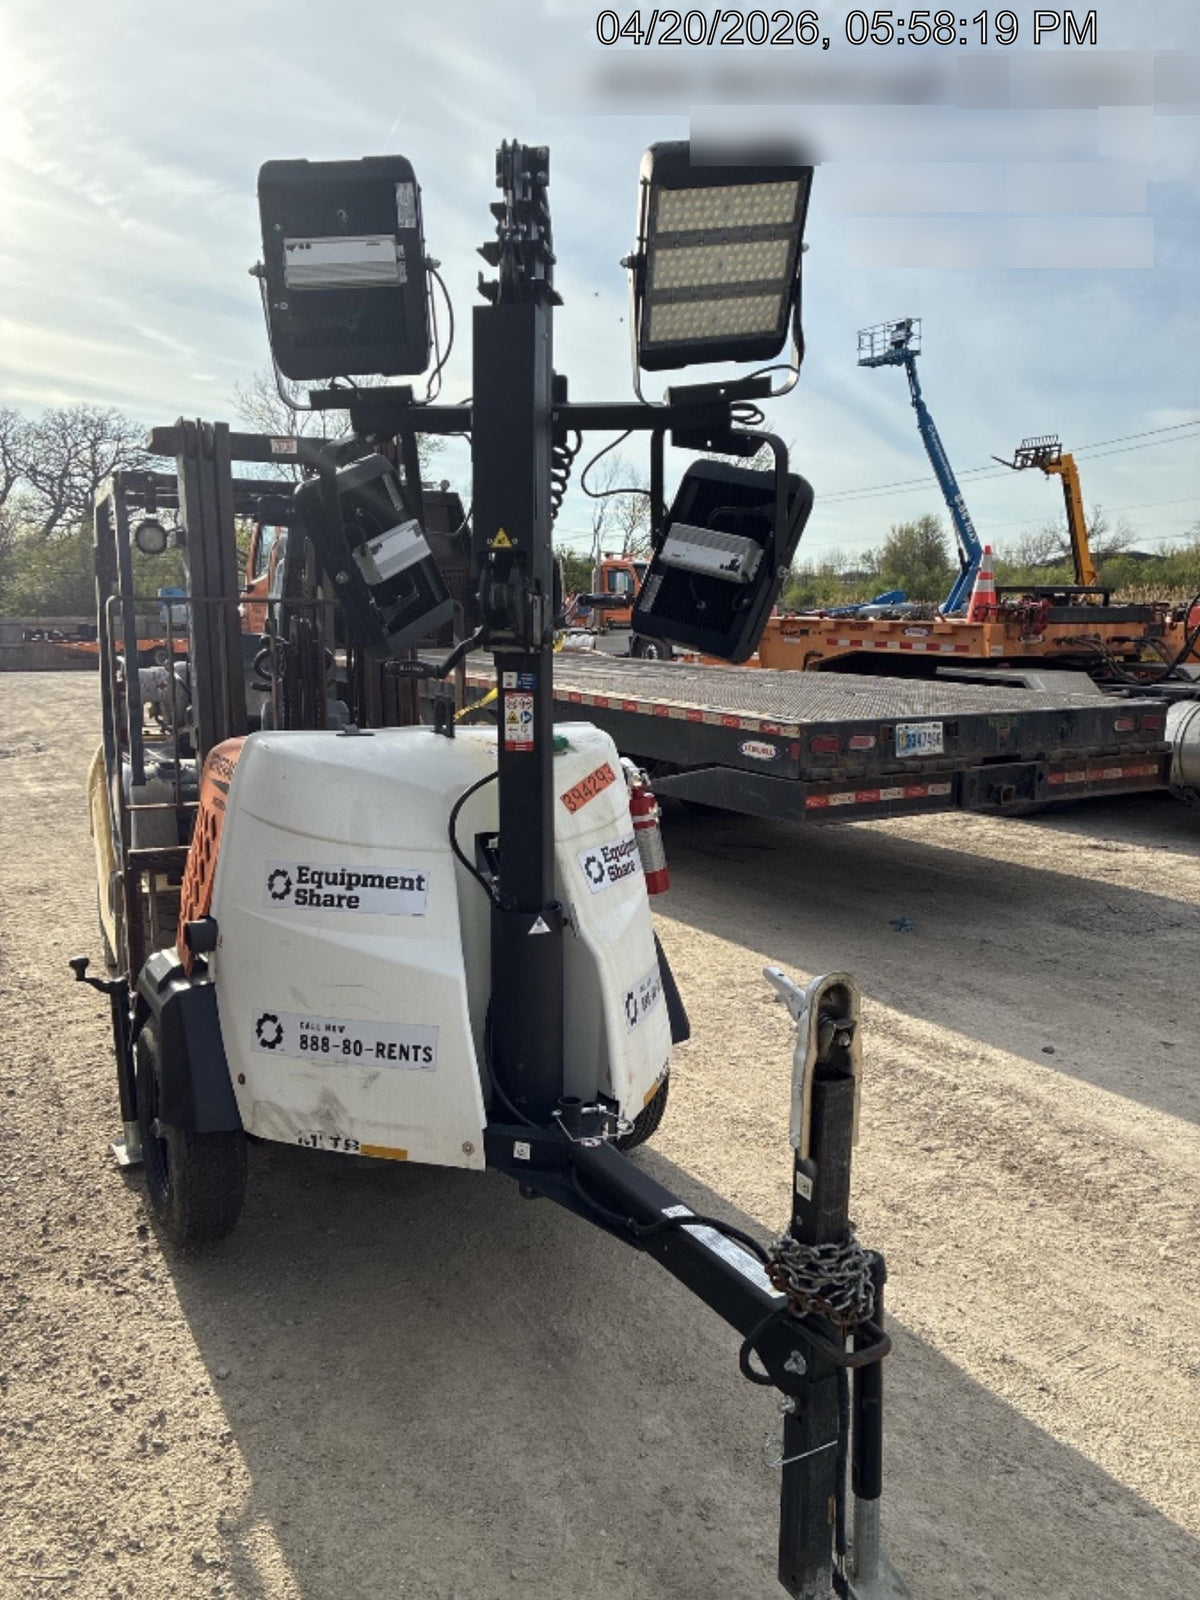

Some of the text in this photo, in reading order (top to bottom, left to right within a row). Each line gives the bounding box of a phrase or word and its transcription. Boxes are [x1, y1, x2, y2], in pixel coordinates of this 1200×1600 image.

[563, 767, 616, 812] 394293
[296, 865, 425, 891] Equipment
[608, 860, 636, 882] Share
[294, 888, 360, 909] Share
[300, 1034, 433, 1063] 888-80-RENTS
